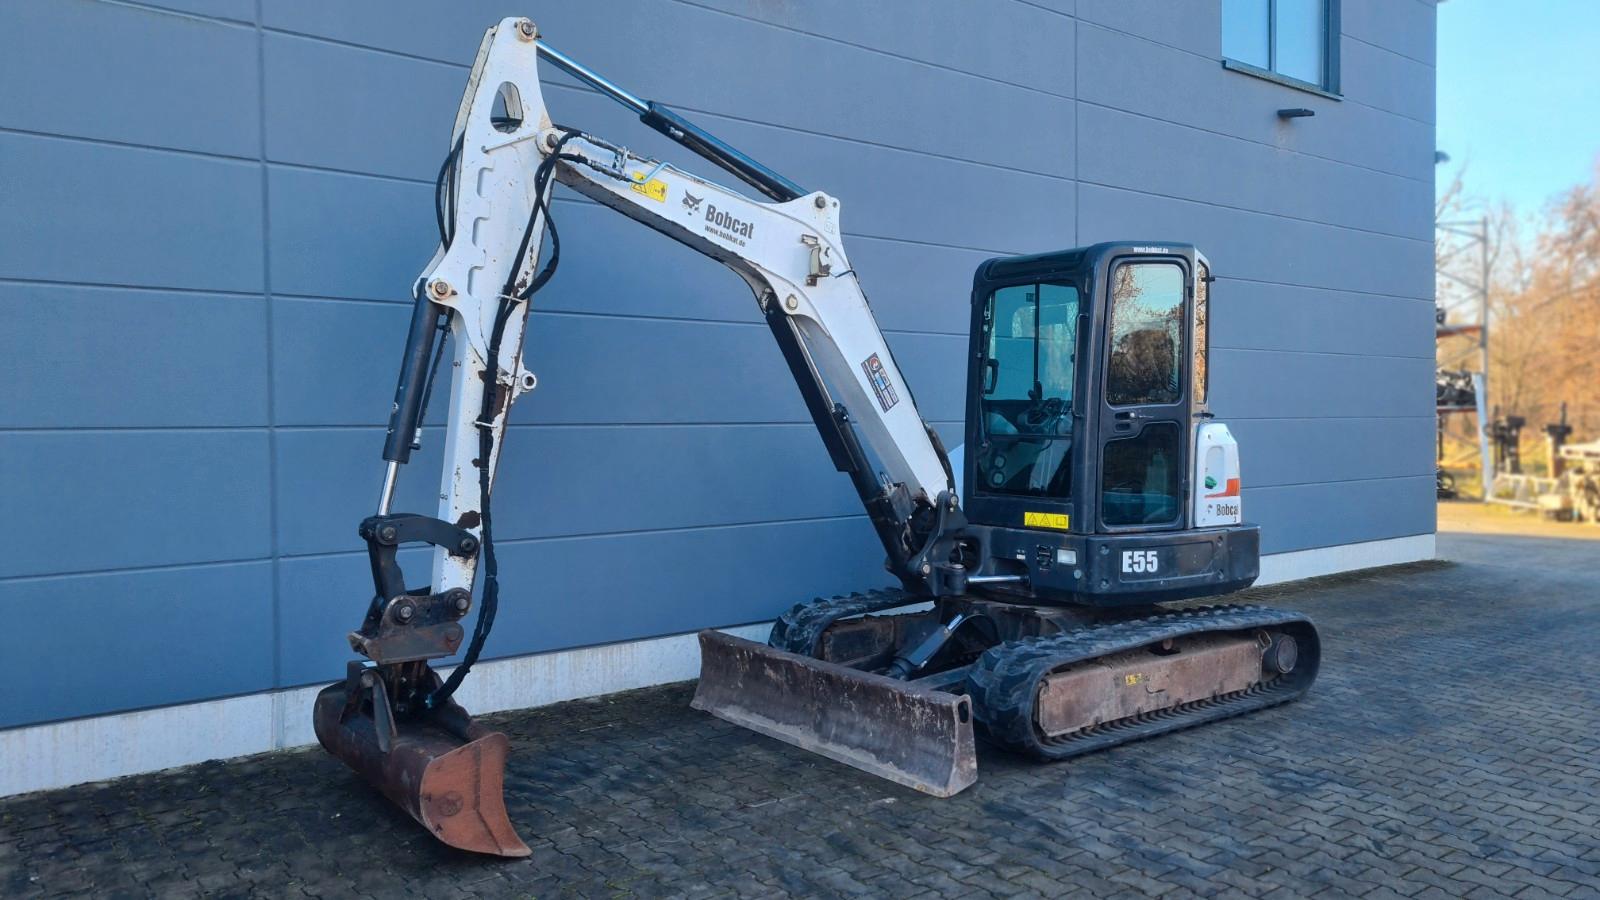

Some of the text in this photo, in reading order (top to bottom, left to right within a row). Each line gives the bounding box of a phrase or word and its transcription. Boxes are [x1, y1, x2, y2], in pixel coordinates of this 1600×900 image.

[705, 204, 754, 240] Bobcat
[1216, 504, 1239, 516] Bobca
[1122, 551, 1159, 573] E55
